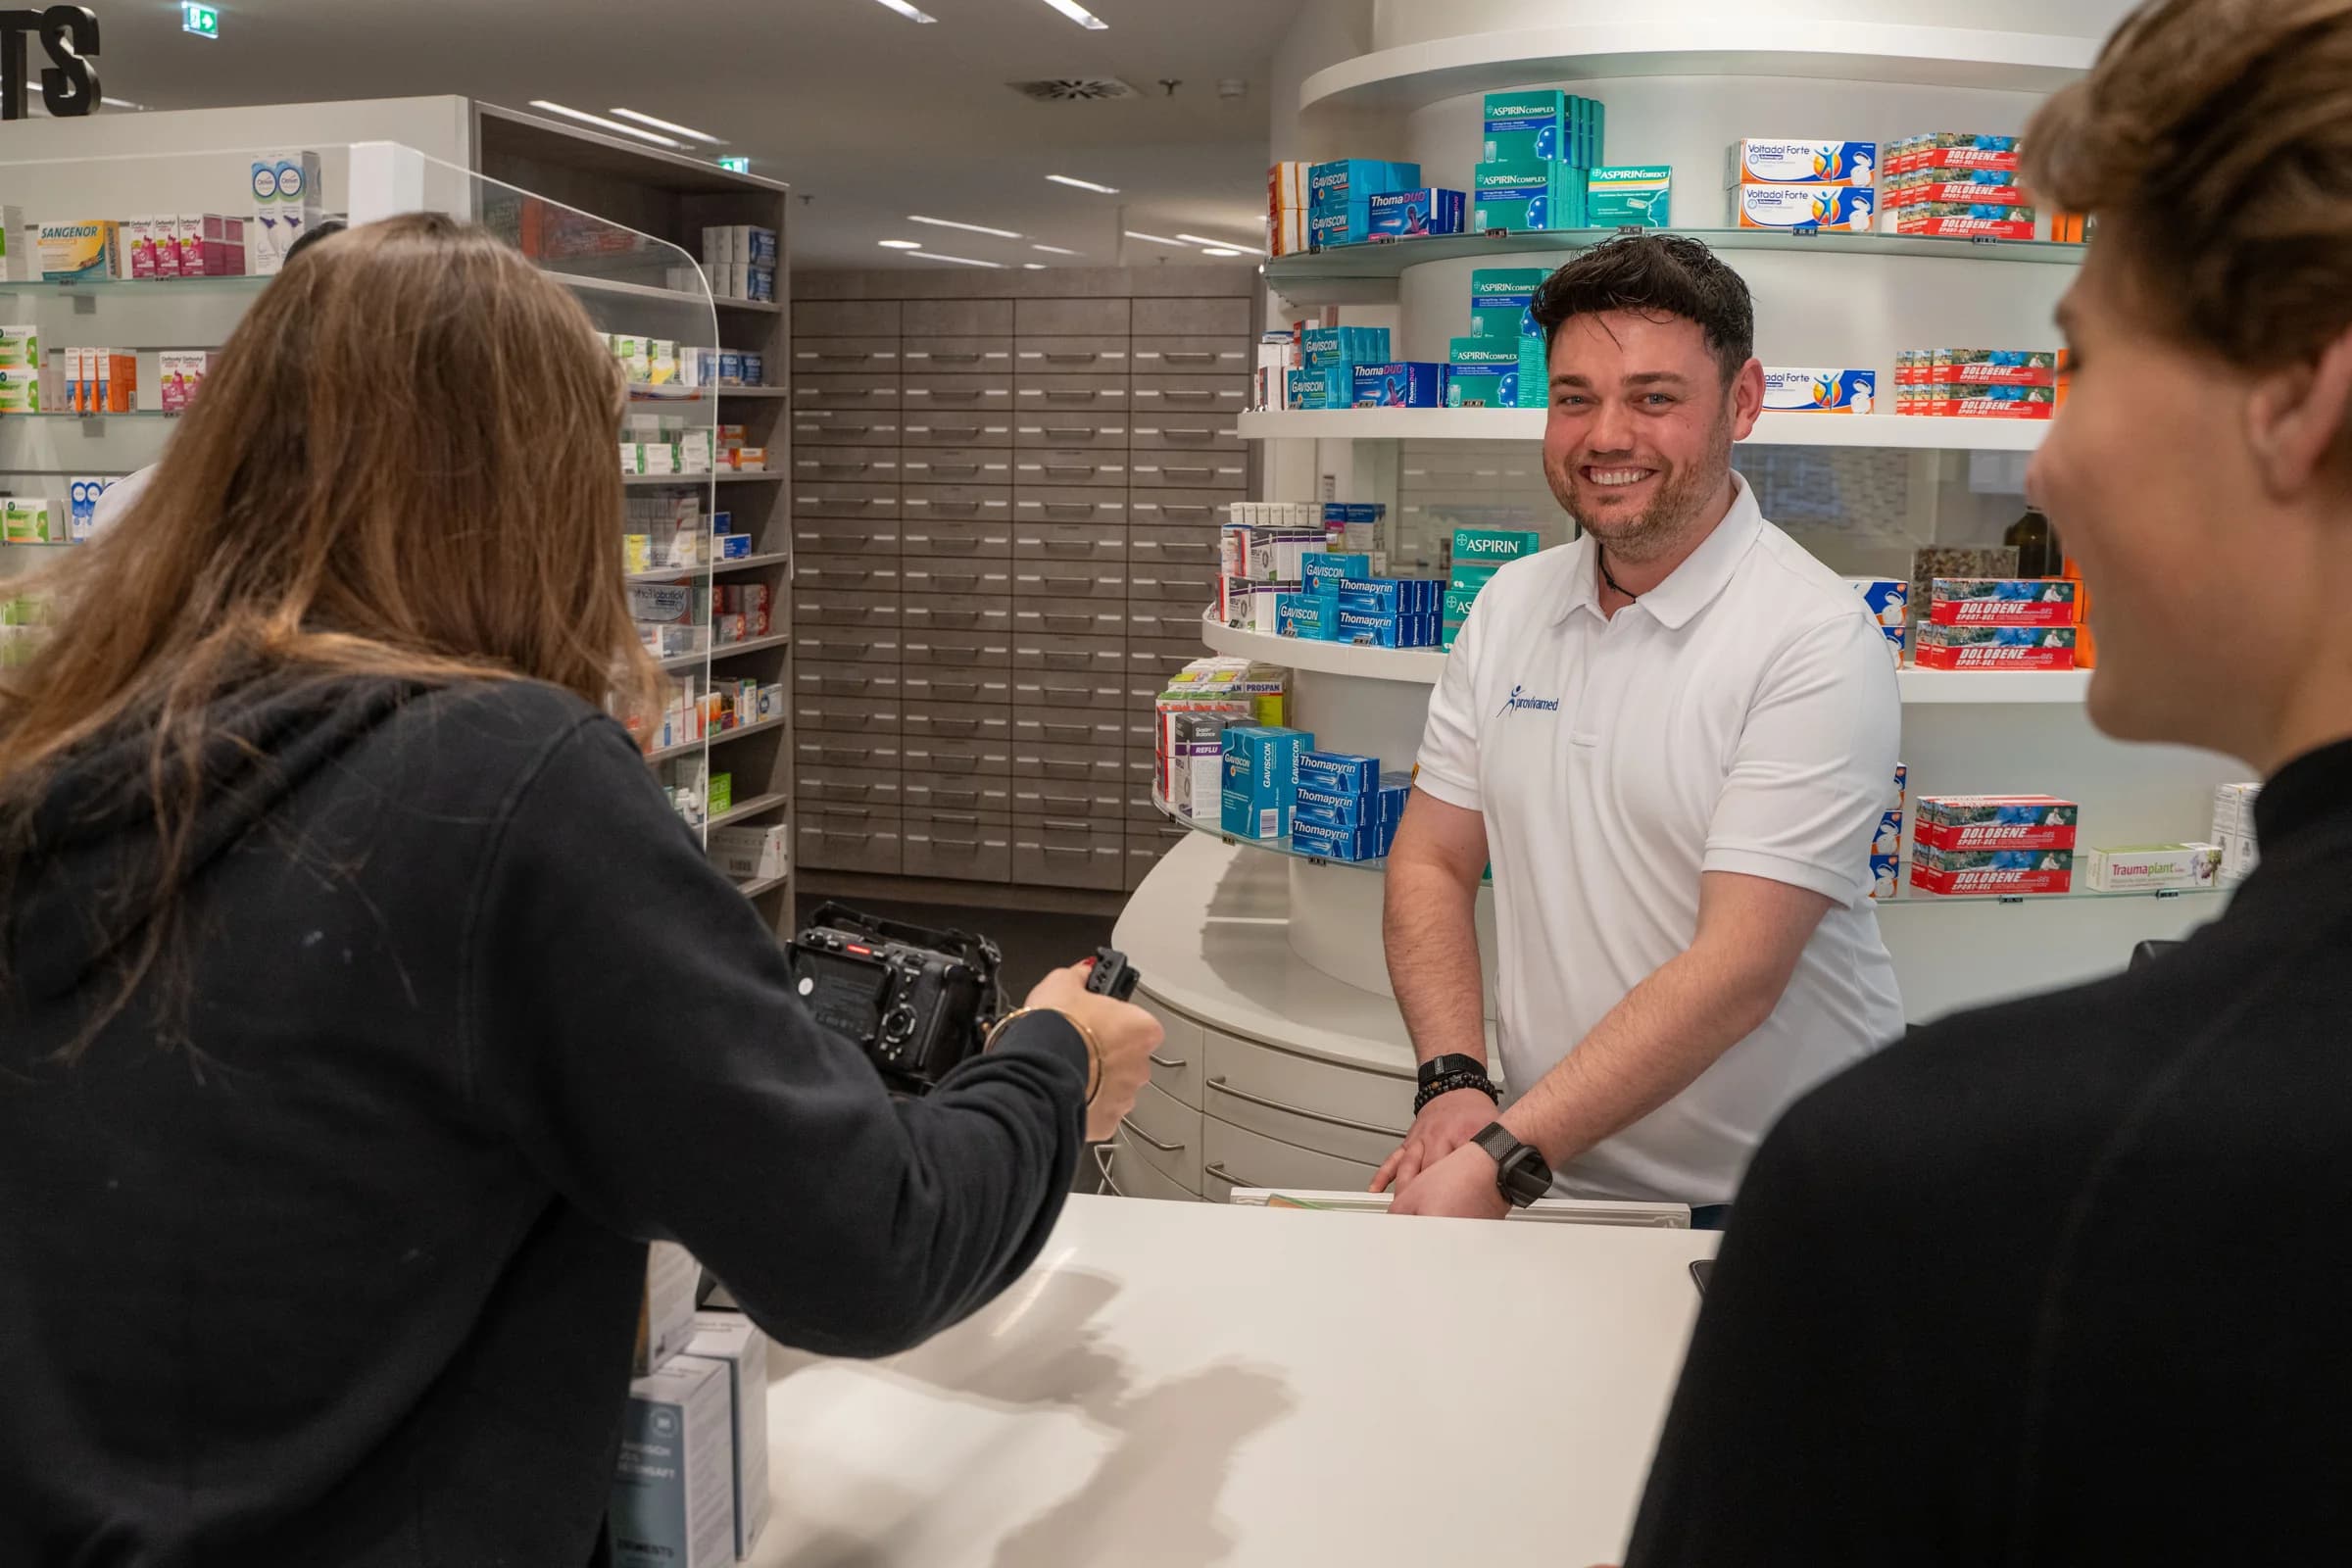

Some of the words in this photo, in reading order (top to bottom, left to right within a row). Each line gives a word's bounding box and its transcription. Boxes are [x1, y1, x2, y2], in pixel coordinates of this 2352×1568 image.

[1493, 106, 1526, 116] ASPIRIN
[1747, 144, 1785, 154] Voltadol
[1787, 145, 1810, 155] Forte
[1947, 150, 1997, 161] DOLOBENE
[1312, 172, 1348, 188] GAVISCON
[1483, 175, 1517, 185] ASPIRIN
[1599, 169, 1643, 179] ASPIRIN
[1746, 189, 1784, 199] Voltadol
[1785, 190, 1808, 200] Forte
[1943, 184, 1995, 195] DOLOBENE
[1372, 191, 1427, 207] ThomaDUO
[1312, 215, 1348, 229] GAVISCON
[1941, 219, 1993, 229] DOLOBENE
[41, 226, 98, 239] SANGENOR
[1480, 283, 1512, 292] ASPIRIN
[1305, 339, 1338, 353] GAVISCON
[1457, 351, 1490, 361] ASPIRIN
[1354, 366, 1403, 377] ThomaDUO
[1787, 373, 1810, 382] Forte
[1963, 367, 2013, 376] DOLOBENE
[1292, 380, 1324, 393] GAVISCON
[1961, 400, 2012, 410] DOLOBENE
[1466, 539, 1518, 554] ASPIRIN
[1306, 564, 1346, 578] GAVISCON
[1340, 578, 1393, 593] Thomapyrin
[1280, 606, 1319, 620] GAVISCON
[1960, 603, 2027, 613] DOLOBENE
[1340, 612, 1392, 627] Thomapyrin
[1960, 648, 2028, 660] DOLOBENE
[1246, 683, 1280, 692] PROSPAN
[1225, 753, 1250, 767] GAVISCON
[1291, 739, 1299, 785] GAVISCON
[1299, 754, 1356, 774] Thomapyrin
[1298, 787, 1353, 808] Thomapyrin
[1294, 819, 1349, 841] Thomapyrin
[1961, 827, 2029, 839] DOLOBENE
[2112, 862, 2174, 877] Traumaplant
[1955, 871, 2024, 884] DOLOBENE
